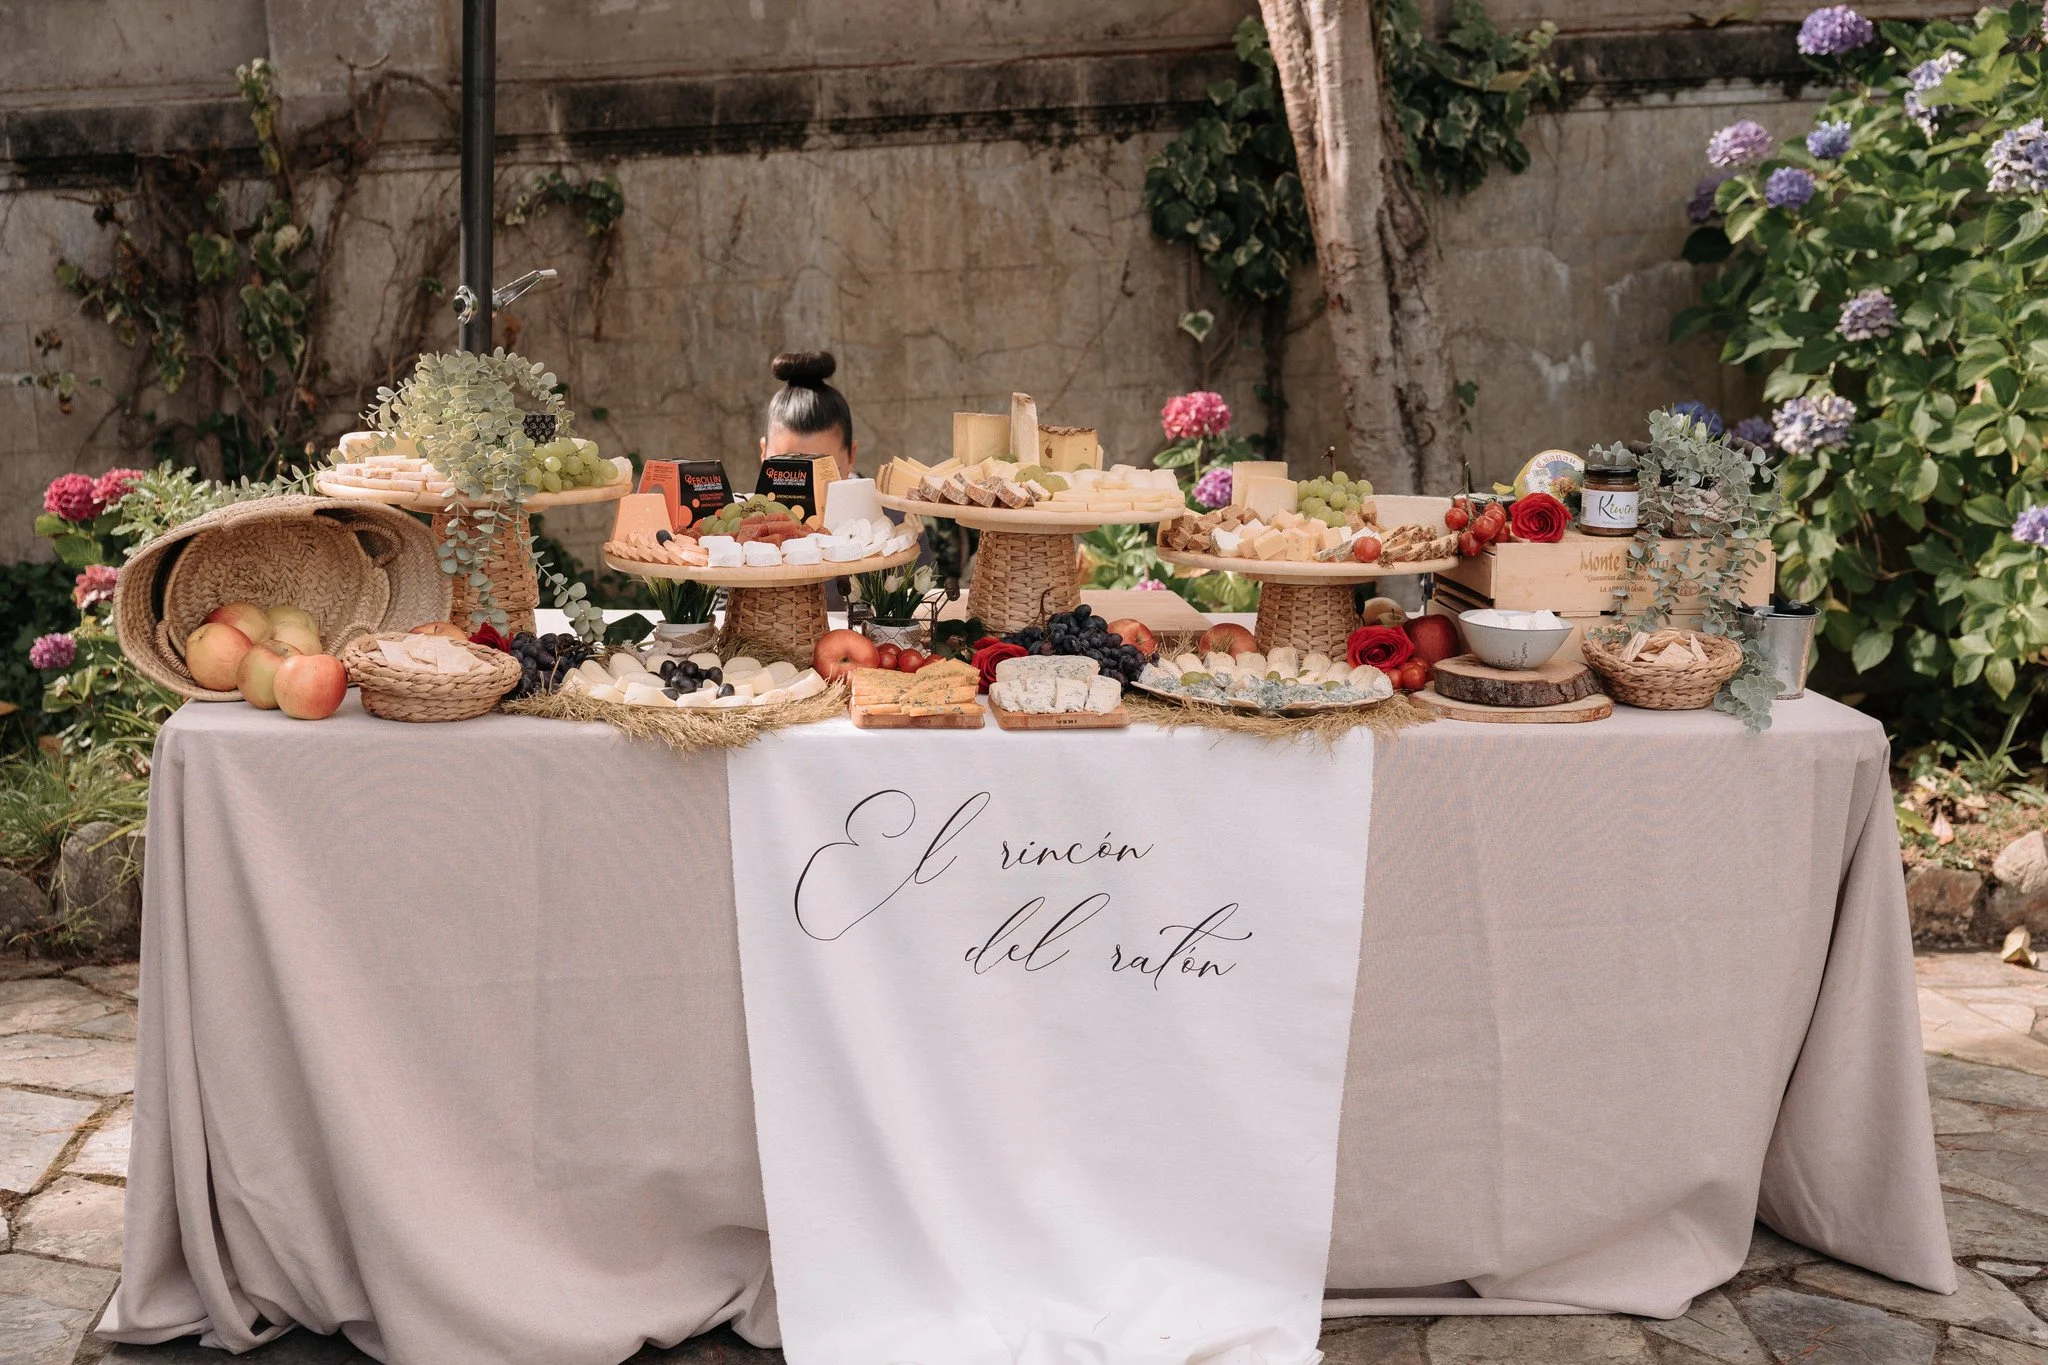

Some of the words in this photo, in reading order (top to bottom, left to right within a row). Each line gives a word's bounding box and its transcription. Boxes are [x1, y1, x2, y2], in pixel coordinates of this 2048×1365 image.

[1580, 550, 1620, 572] Monte
[794, 789, 991, 941] El
[1001, 831, 1154, 870] rincón
[964, 893, 1110, 975] del
[1111, 903, 1252, 991] ratón
